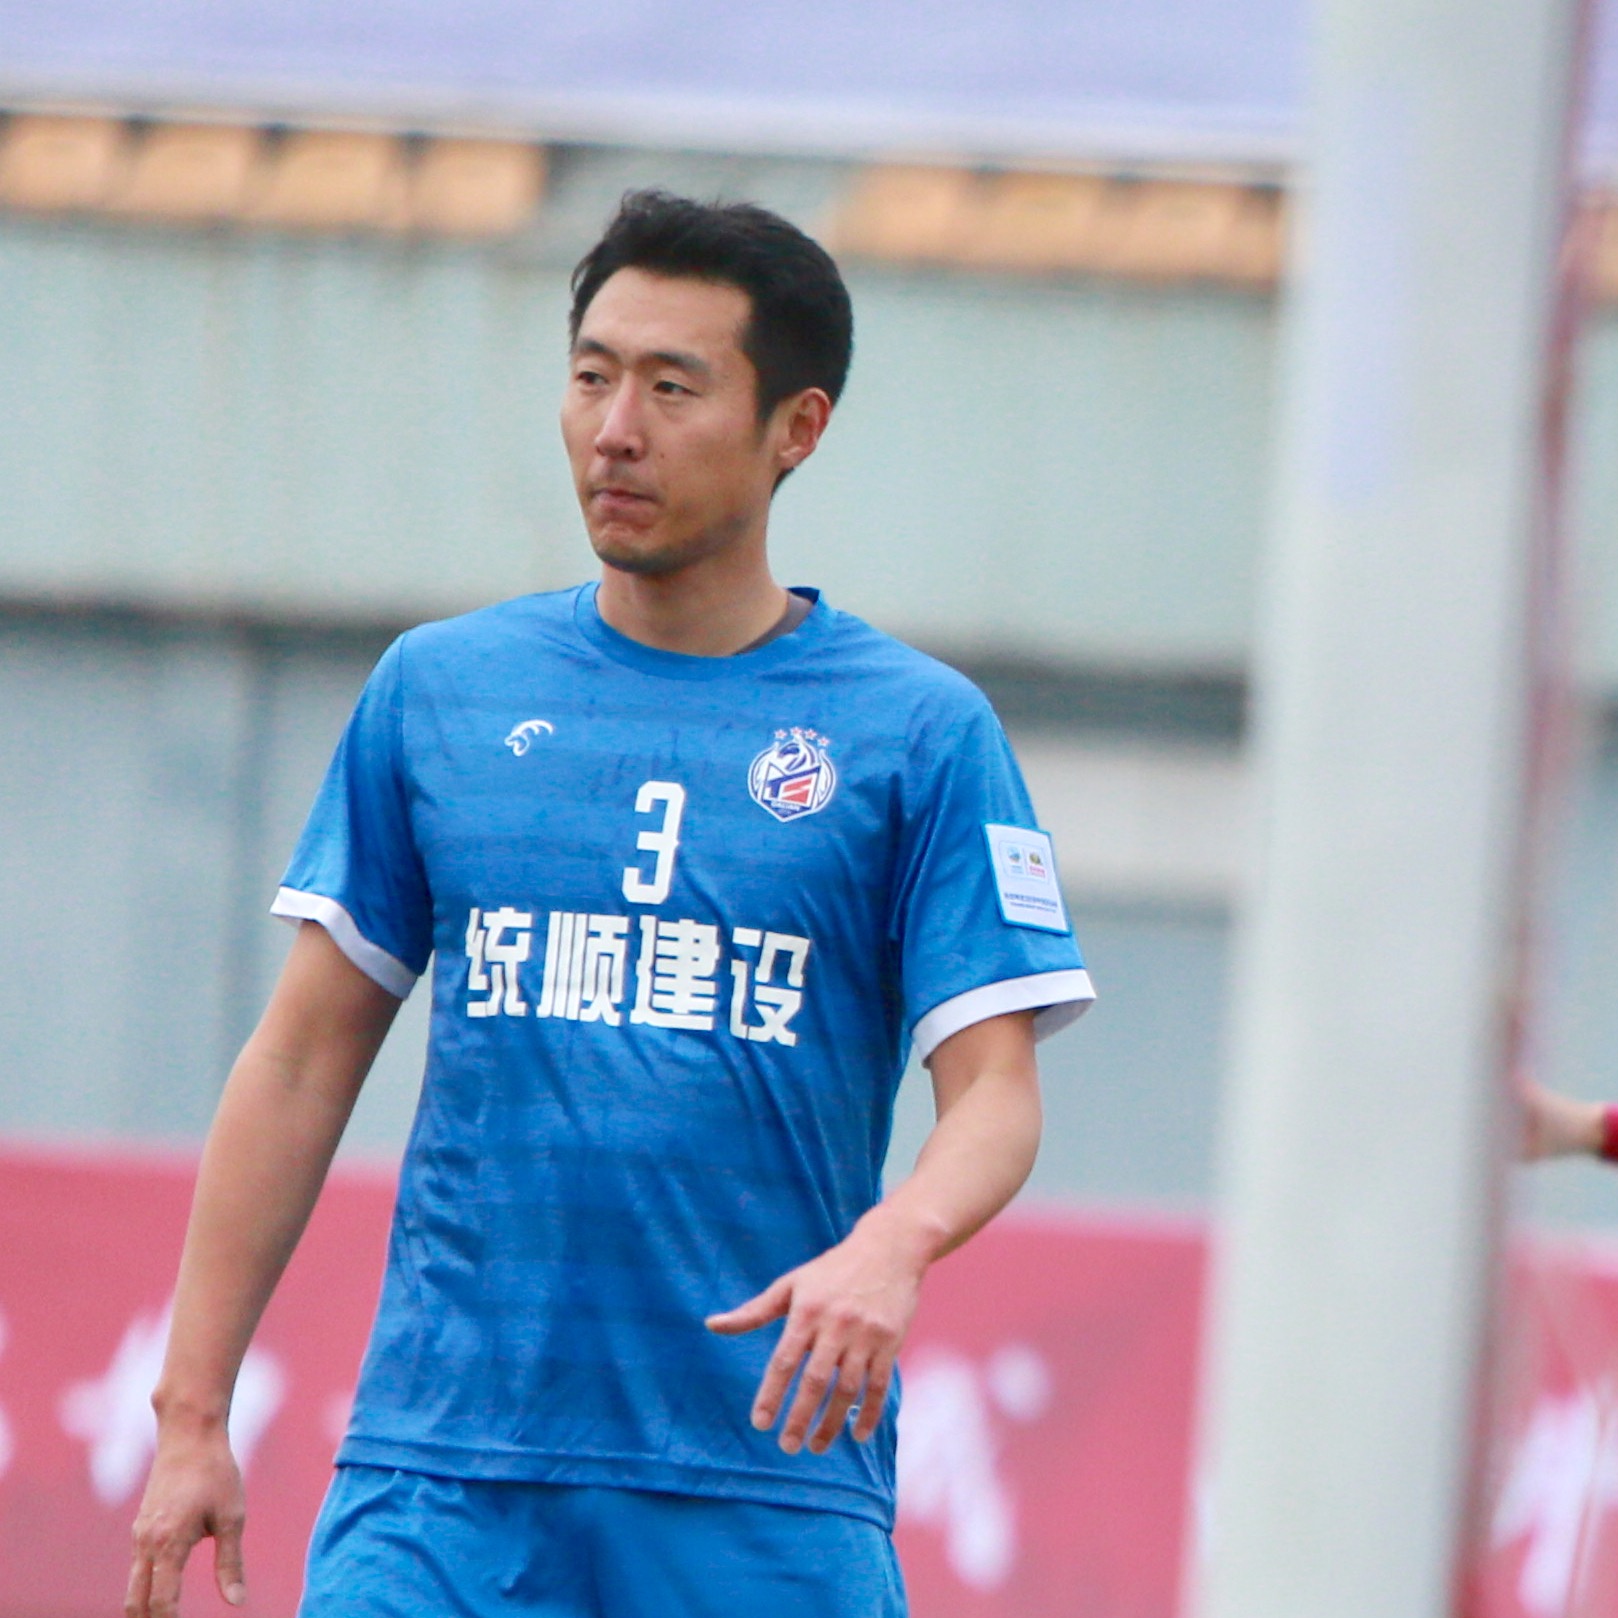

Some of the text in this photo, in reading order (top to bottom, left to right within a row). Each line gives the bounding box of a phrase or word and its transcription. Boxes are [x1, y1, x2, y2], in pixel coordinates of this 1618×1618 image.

[622, 780, 685, 904] 3
[465, 907, 810, 1047] 统顺建设
